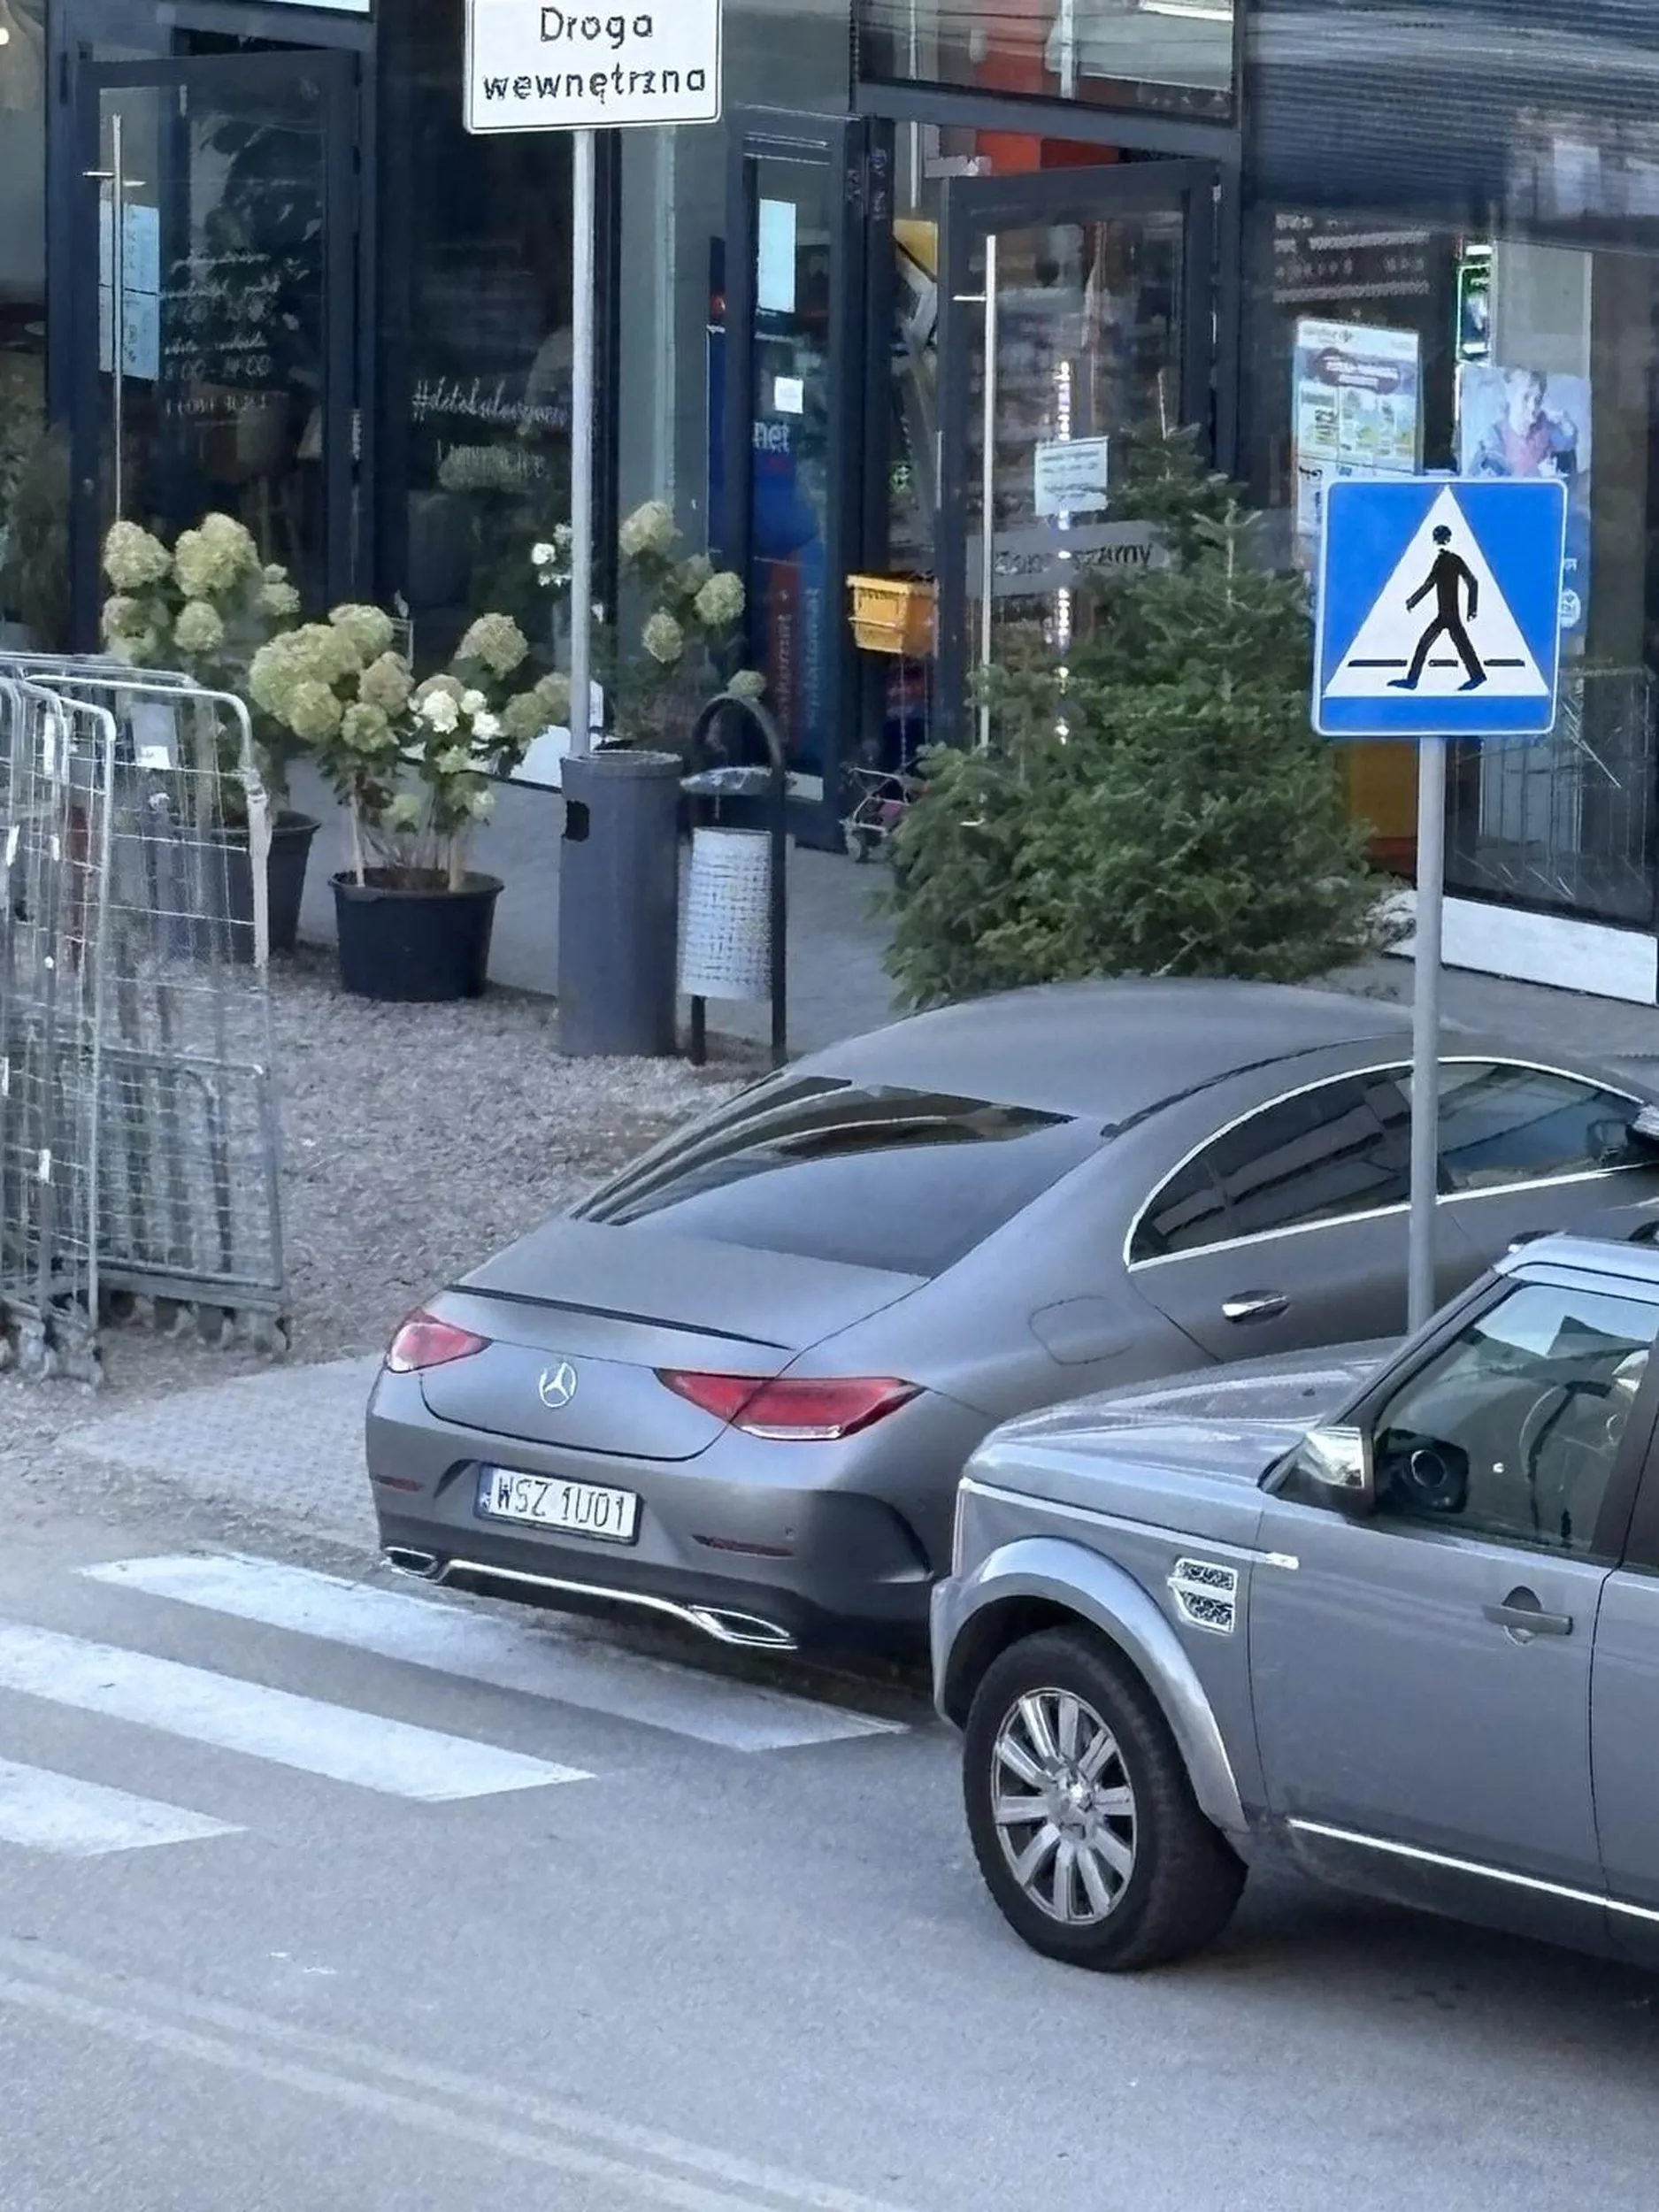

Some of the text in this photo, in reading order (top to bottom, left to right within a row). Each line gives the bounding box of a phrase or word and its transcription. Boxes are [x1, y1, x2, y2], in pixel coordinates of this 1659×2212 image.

[541, 7, 653, 50] Droga
[483, 62, 706, 105] wewnętrzna
[497, 1476, 553, 1517] WSZ
[562, 1485, 625, 1532] 1U01
